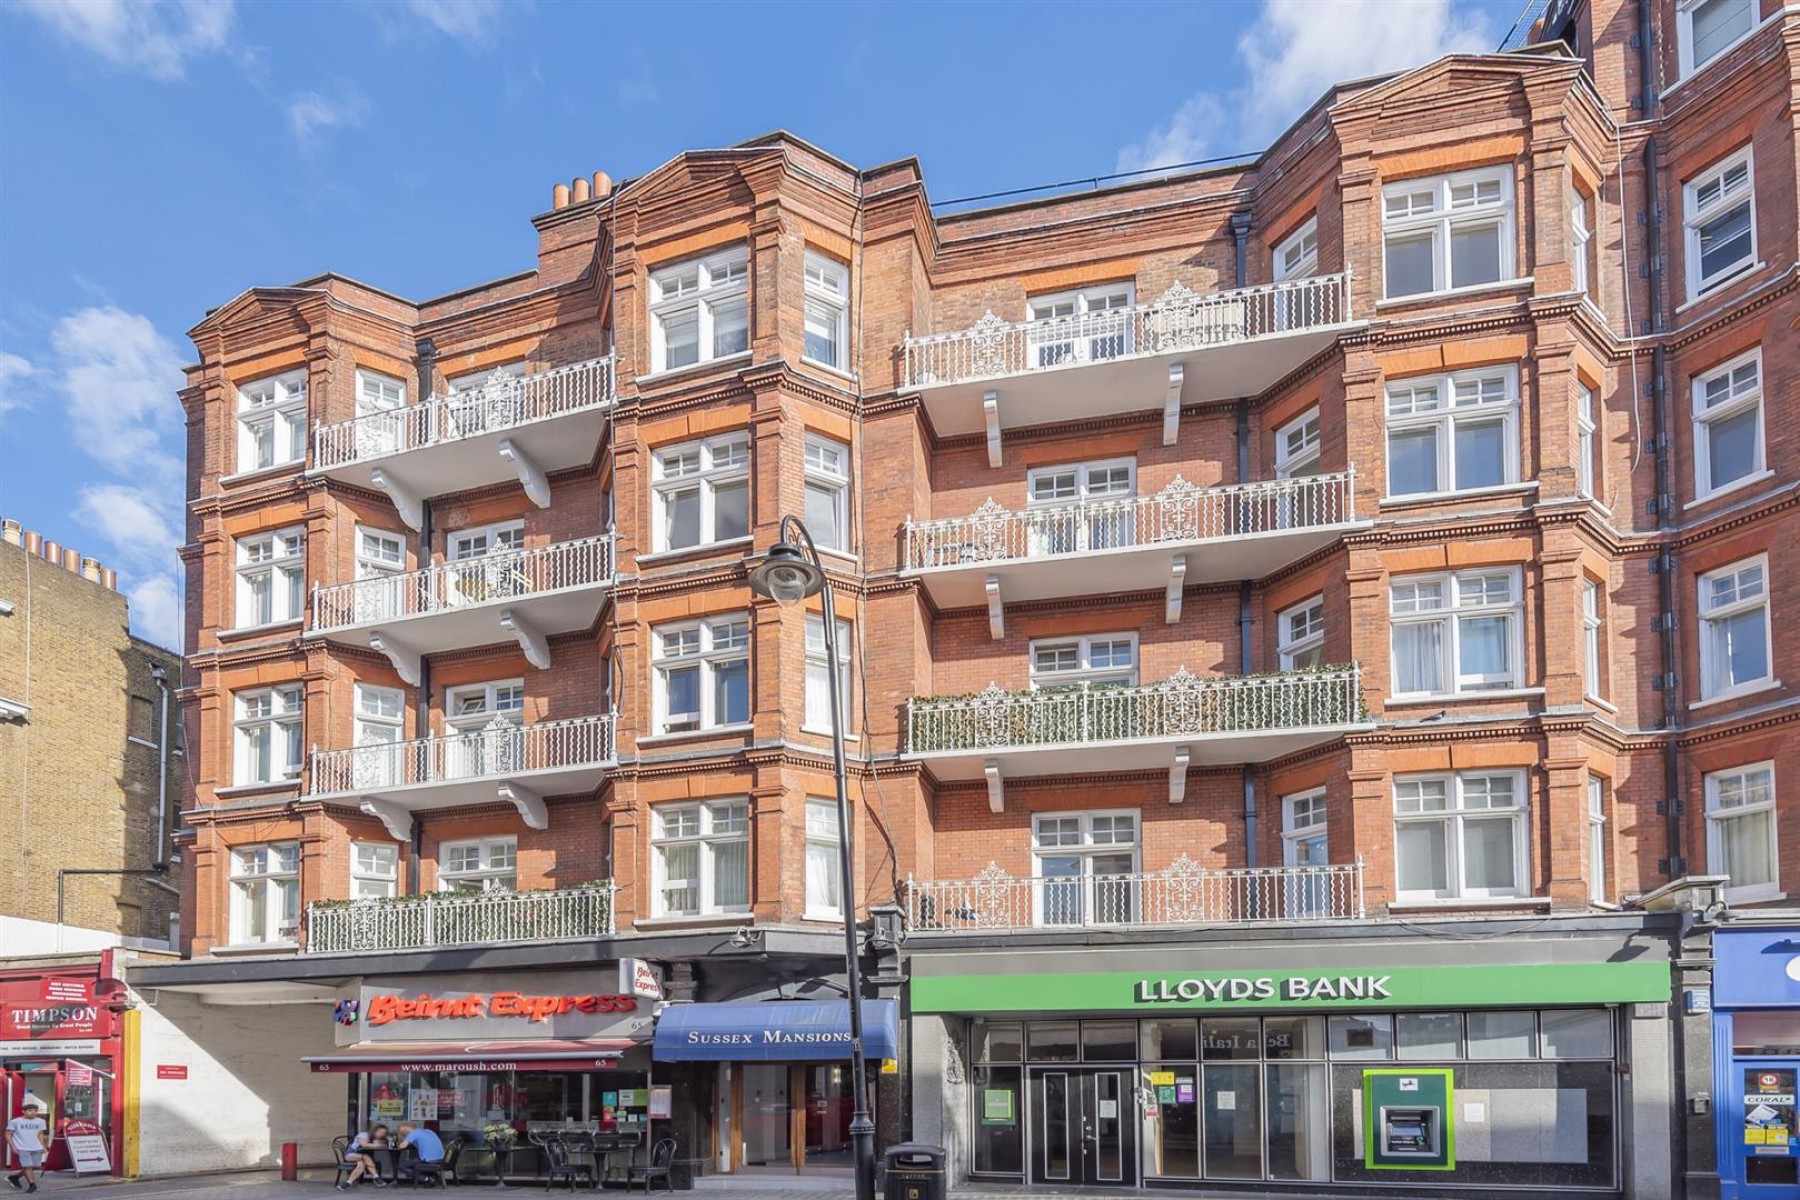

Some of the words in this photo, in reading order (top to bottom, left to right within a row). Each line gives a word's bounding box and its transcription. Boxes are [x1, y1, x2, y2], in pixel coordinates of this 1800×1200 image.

[635, 978, 664, 992] Express
[1139, 977, 1274, 1000] LLOYDS
[1288, 975, 1392, 998] BANK
[11, 1006, 98, 1023] TIMPSON
[367, 994, 483, 1025] Beirut
[490, 992, 637, 1021] Express
[631, 1021, 643, 1030] 65
[688, 1031, 753, 1044] SUSSEX
[763, 1030, 852, 1043] MANSIONS
[320, 1063, 330, 1071] 65
[401, 1061, 517, 1071] www.maroush.com
[595, 1059, 607, 1067] 65
